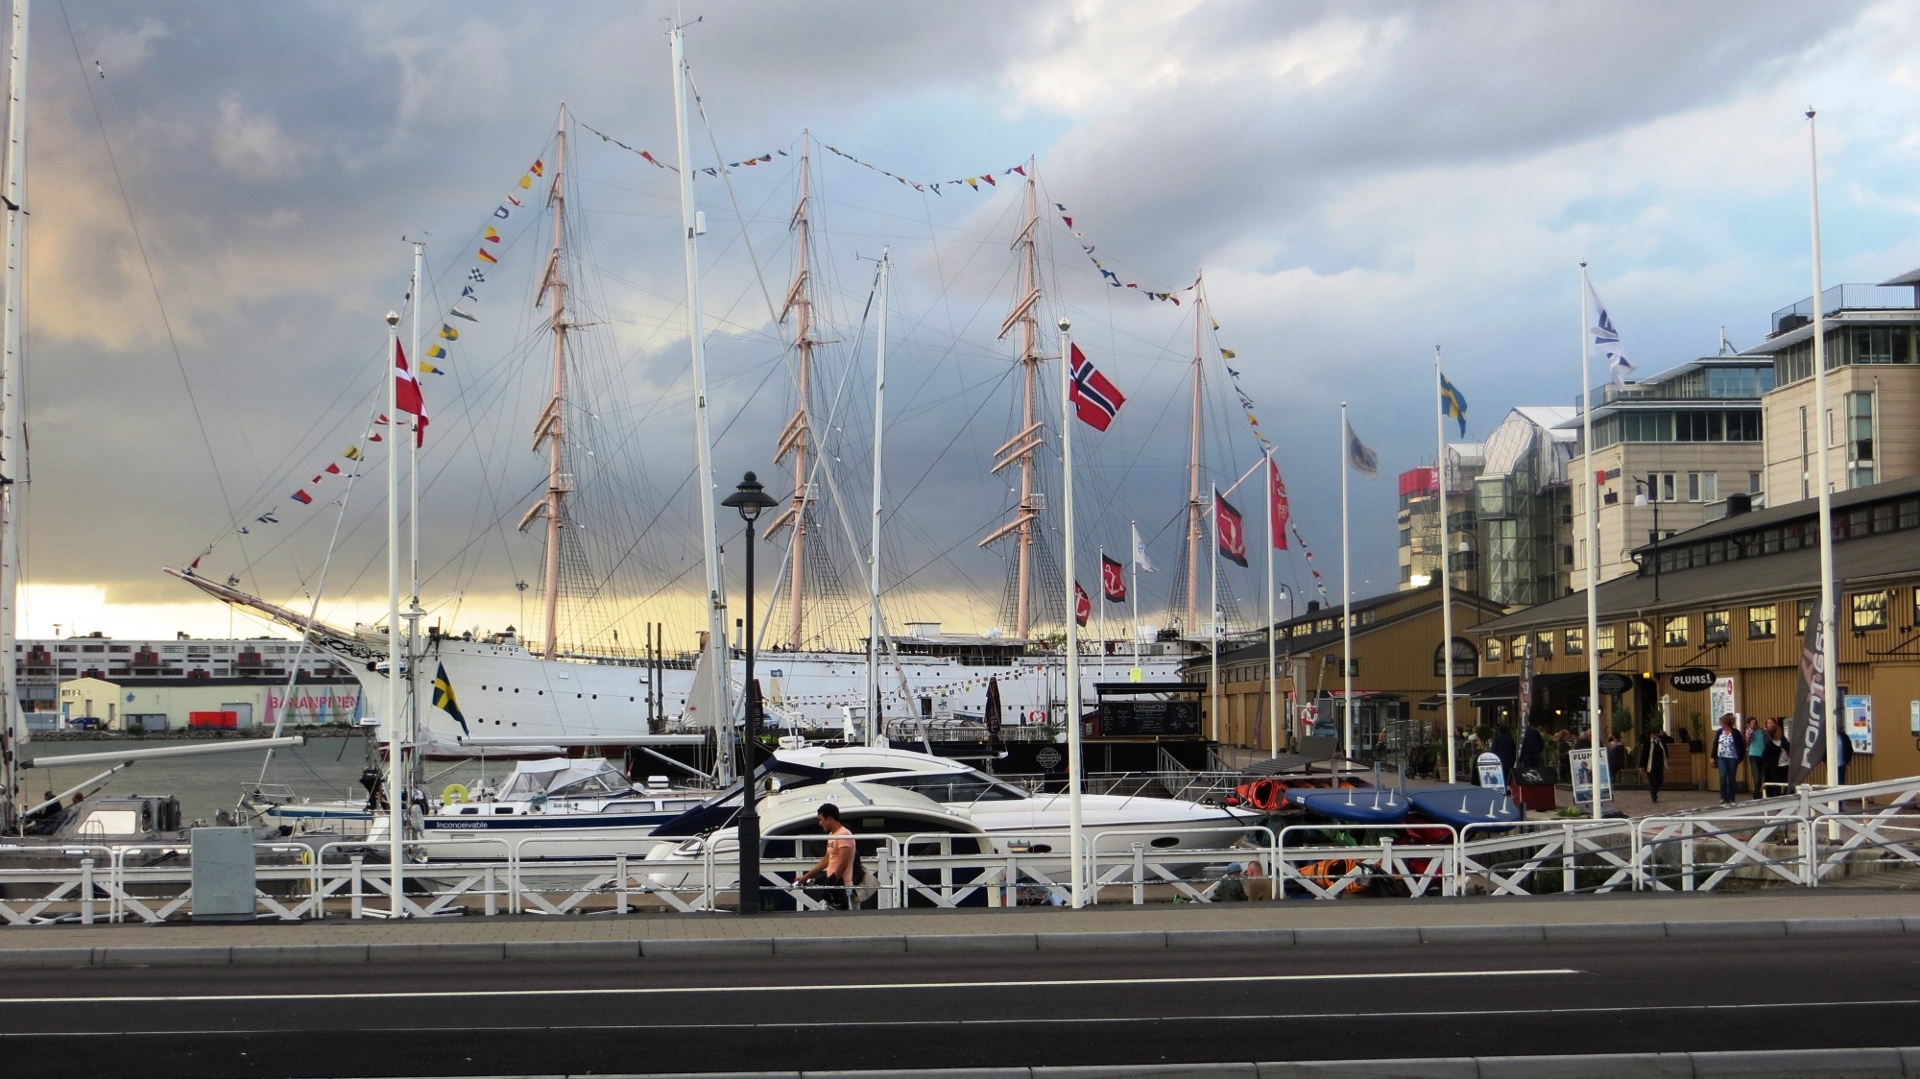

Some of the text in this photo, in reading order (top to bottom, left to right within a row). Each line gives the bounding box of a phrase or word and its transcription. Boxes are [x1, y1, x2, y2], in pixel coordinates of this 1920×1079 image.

[1674, 674, 1713, 685] PLUMS!
[1573, 749, 1603, 760] PLUM!
[436, 821, 488, 829] Inconceivable
